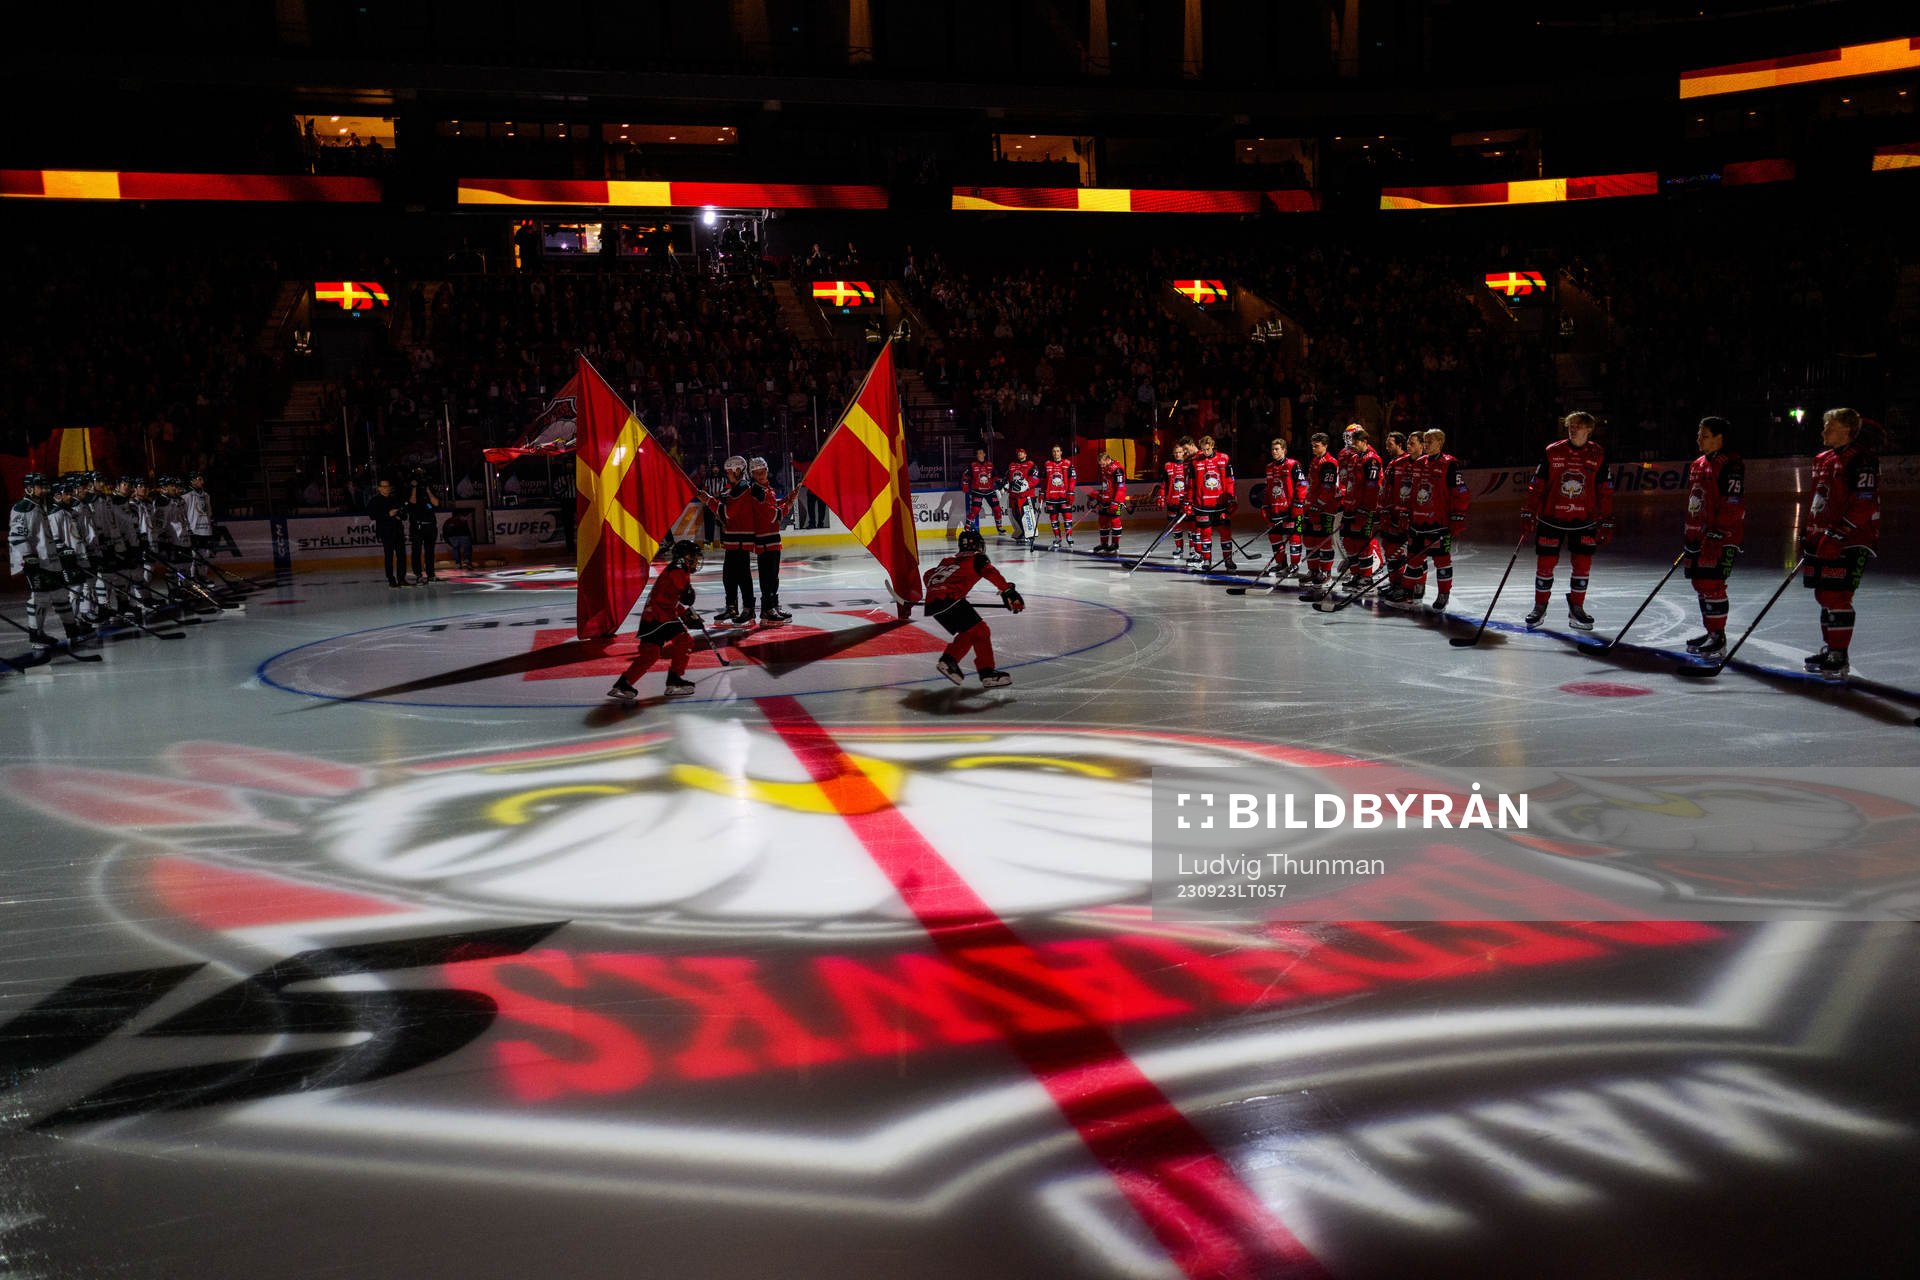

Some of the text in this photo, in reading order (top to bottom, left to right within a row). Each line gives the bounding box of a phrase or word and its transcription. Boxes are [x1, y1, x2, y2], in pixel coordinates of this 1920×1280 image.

[1614, 464, 1689, 491] hlsel
[1857, 472, 1875, 489] 20
[913, 509, 950, 523] sClub
[495, 521, 551, 536] SUPER
